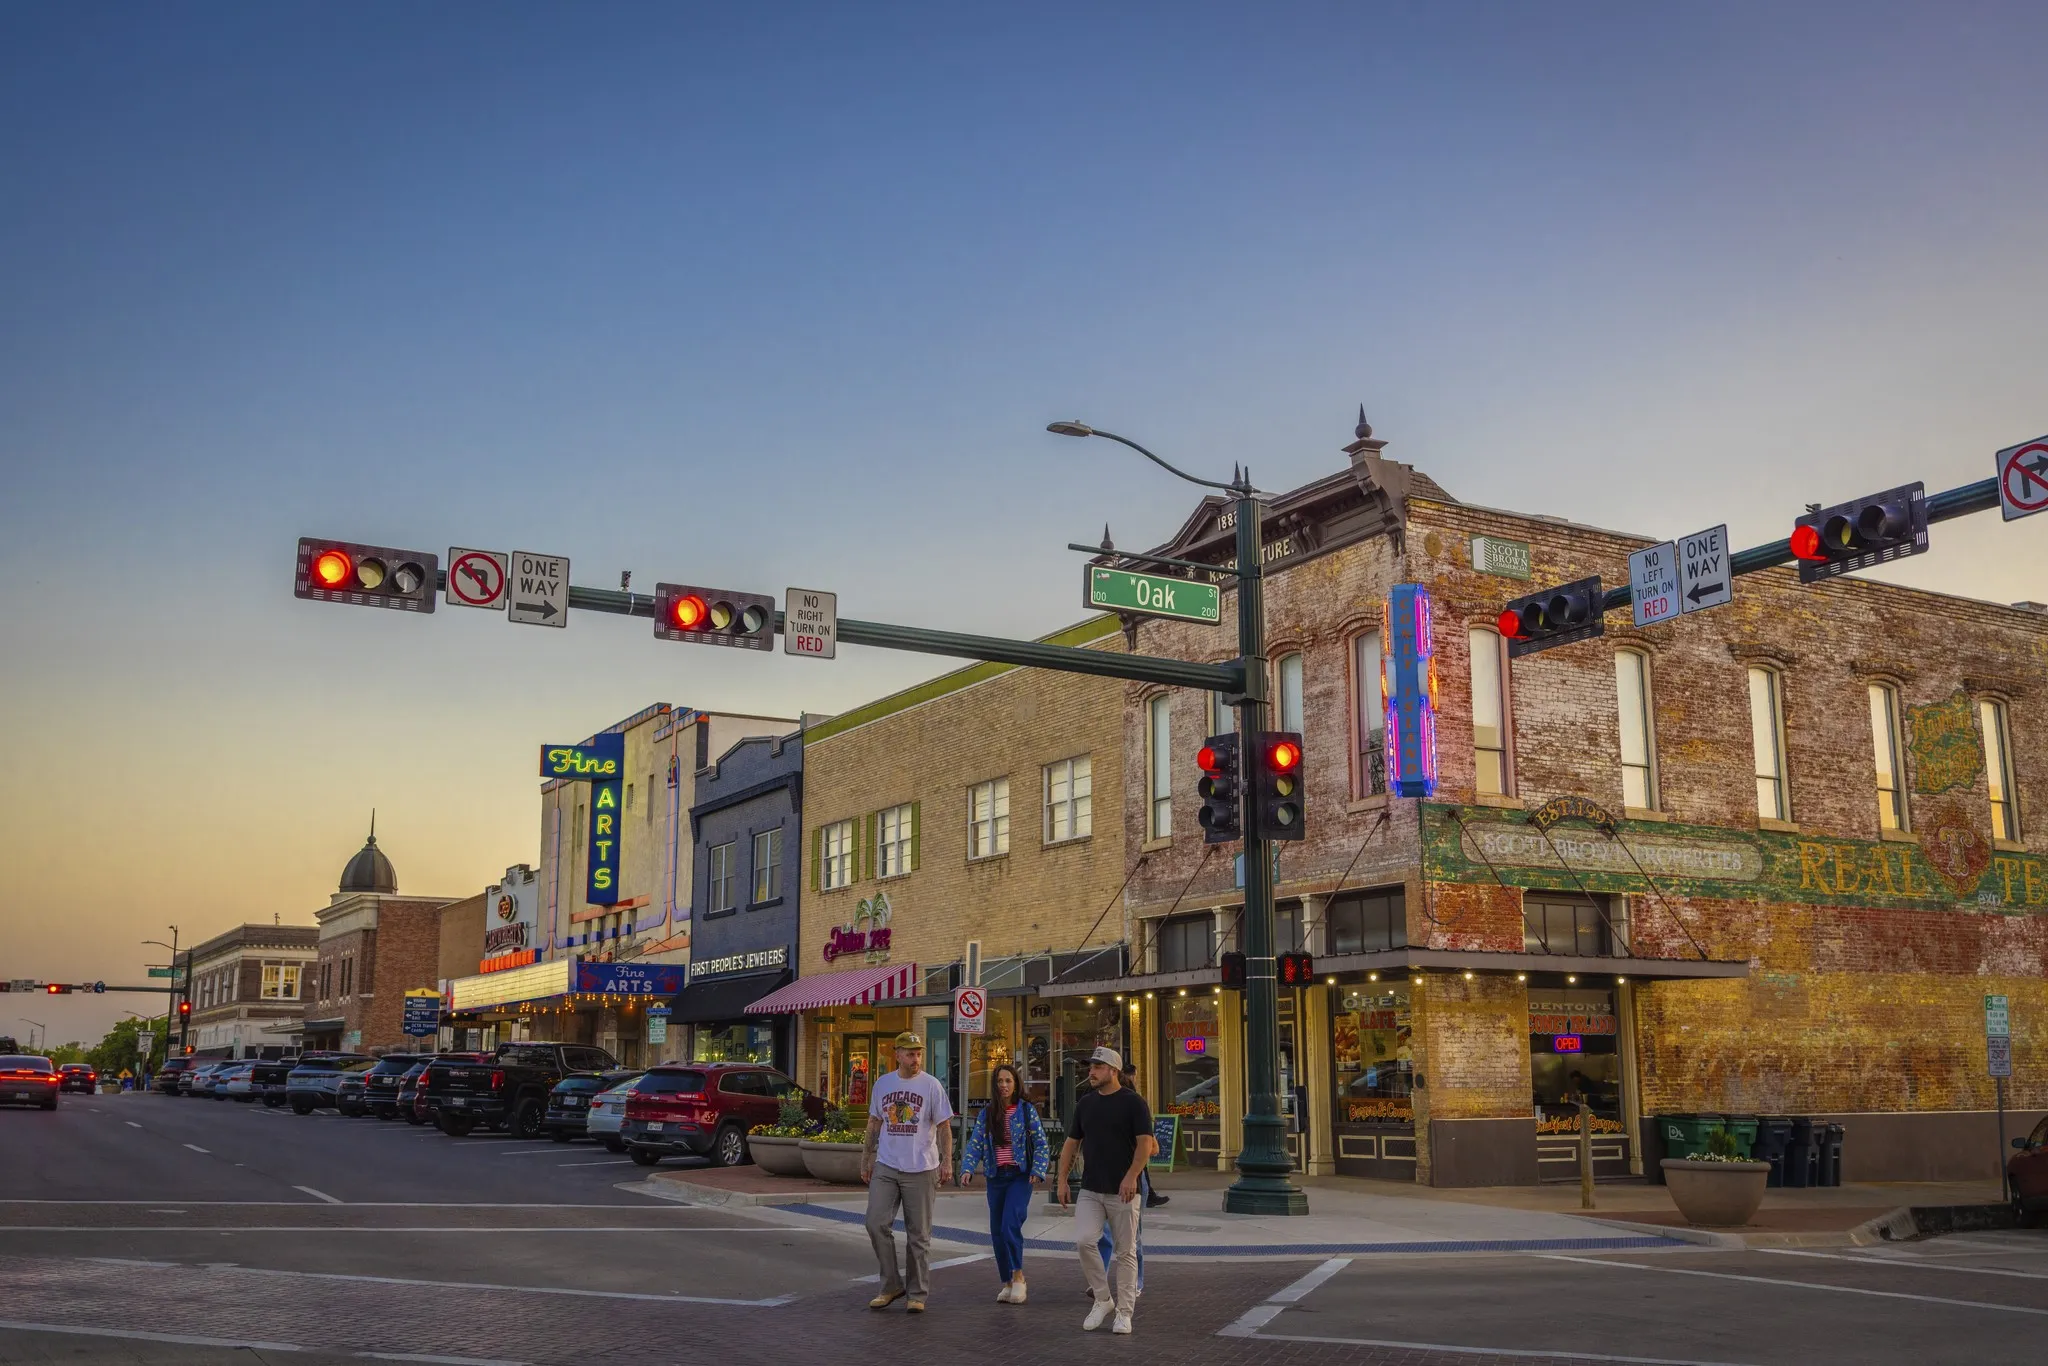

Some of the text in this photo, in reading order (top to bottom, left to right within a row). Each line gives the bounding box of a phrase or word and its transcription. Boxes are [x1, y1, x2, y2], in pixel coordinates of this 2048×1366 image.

[1491, 544, 1528, 559] SCOTT
[1686, 534, 1719, 559] ONE
[522, 559, 559, 578] ONE
[1492, 554, 1528, 567] BROWN
[1492, 561, 1528, 571] COMMERCIAL
[1644, 552, 1659, 568] NO
[1687, 554, 1720, 580] WAY
[1642, 567, 1664, 584] LEFT
[520, 577, 560, 596] WAY
[1130, 577, 1217, 610] W Oak St
[1636, 578, 1674, 600] TURN ON
[804, 595, 819, 608] NO
[1093, 591, 1107, 602] 100
[797, 609, 824, 622] RIGHT
[1201, 607, 1217, 618] 200
[1644, 597, 1668, 619] RED
[790, 620, 831, 636] TURN ON
[1400, 597, 1413, 670] CONEY
[797, 635, 823, 652] RED
[1404, 687, 1417, 776] ISLAND
[548, 748, 616, 774] Fine
[594, 788, 615, 889] ARTS
[1484, 833, 1546, 857] SCOTT
[1797, 841, 1927, 897] REAL
[690, 948, 784, 977] FIRST PEOPLE'S JEWELERS
[615, 965, 645, 979] Fine
[605, 979, 653, 992] ARTS
[1342, 994, 1411, 1010] OPEN
[1529, 1002, 1611, 1011] DENTON'S
[1986, 998, 1992, 1009] 2
[650, 1019, 656, 1028] 2
[1360, 1010, 1396, 1030] LATE
[1528, 1014, 1616, 1035] CONEY ISLAND
[1186, 1039, 1204, 1051] OPEN
[1555, 1037, 1580, 1050] OPEN
[882, 1091, 924, 1108] CHICAGO
[1349, 1104, 1377, 1120] Burgers
[1377, 1102, 1387, 1118] &
[1588, 1113, 1623, 1134] Burgers
